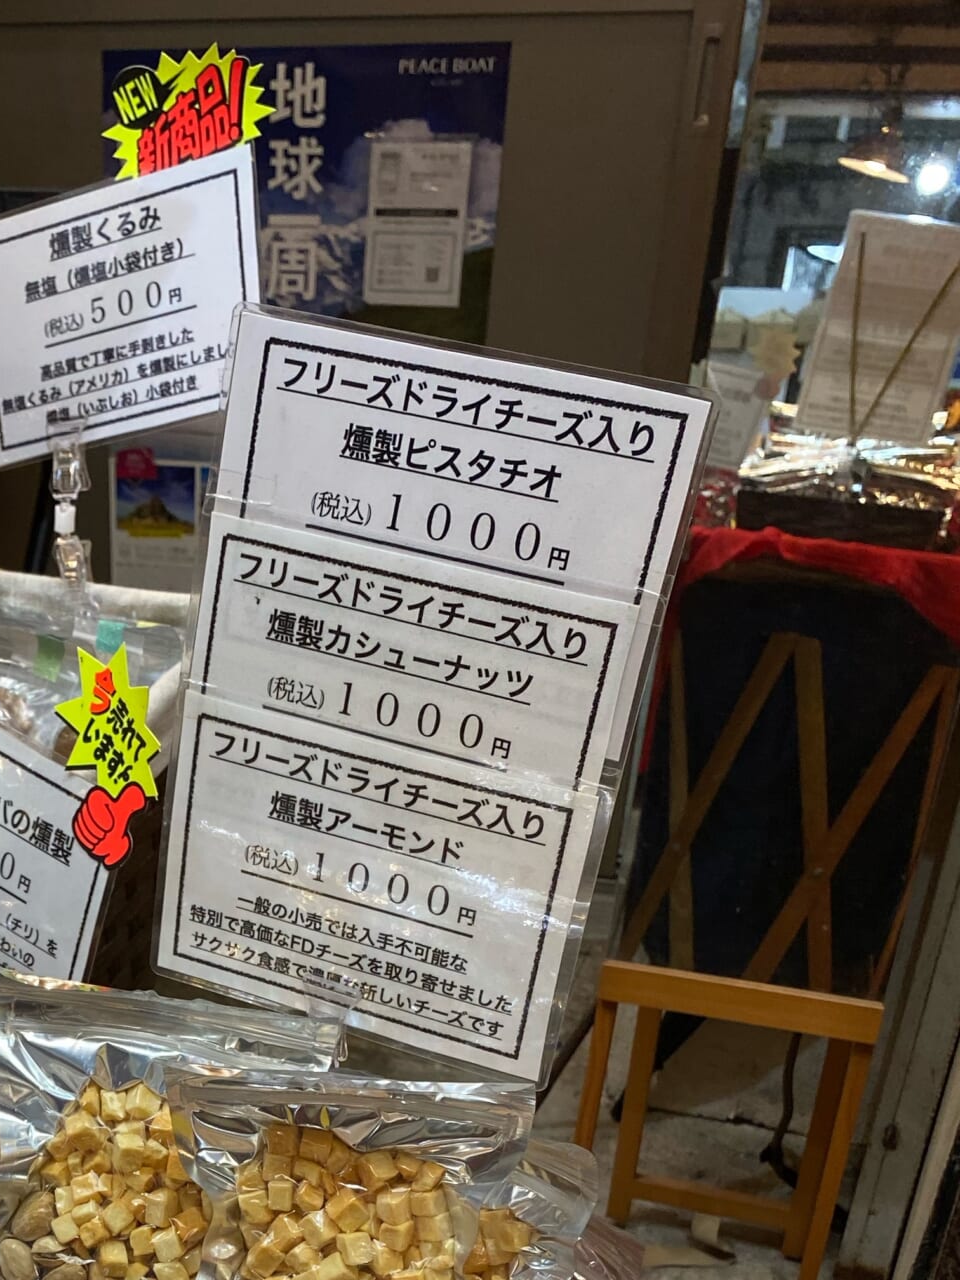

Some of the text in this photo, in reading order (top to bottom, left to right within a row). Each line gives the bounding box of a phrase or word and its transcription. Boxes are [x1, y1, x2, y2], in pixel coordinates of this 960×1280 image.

[112, 72, 158, 125] NEW
[398, 56, 496, 75] PEACE BOAT
[265, 62, 327, 300] 地球一周
[49, 205, 161, 260] 燻製くるみ
[2, 344, 229, 415] 無塩くるみ（アメリカ）を燻製にしまし
[283, 357, 655, 458] フリーズドライチーズ入り
[340, 423, 562, 499] 燻製ピスタチオ
[240, 554, 588, 660] フリーズドライチーズ入り
[266, 609, 534, 698] 燻製カシューナッツ
[213, 732, 545, 840] フリーズドライチーズ入り
[269, 791, 465, 864] 燻製アーモンド
[189, 905, 513, 1014] 特別で高価なFDチーズを取り寄せました
[237, 895, 468, 973] 一般の小売では入手不可能な
